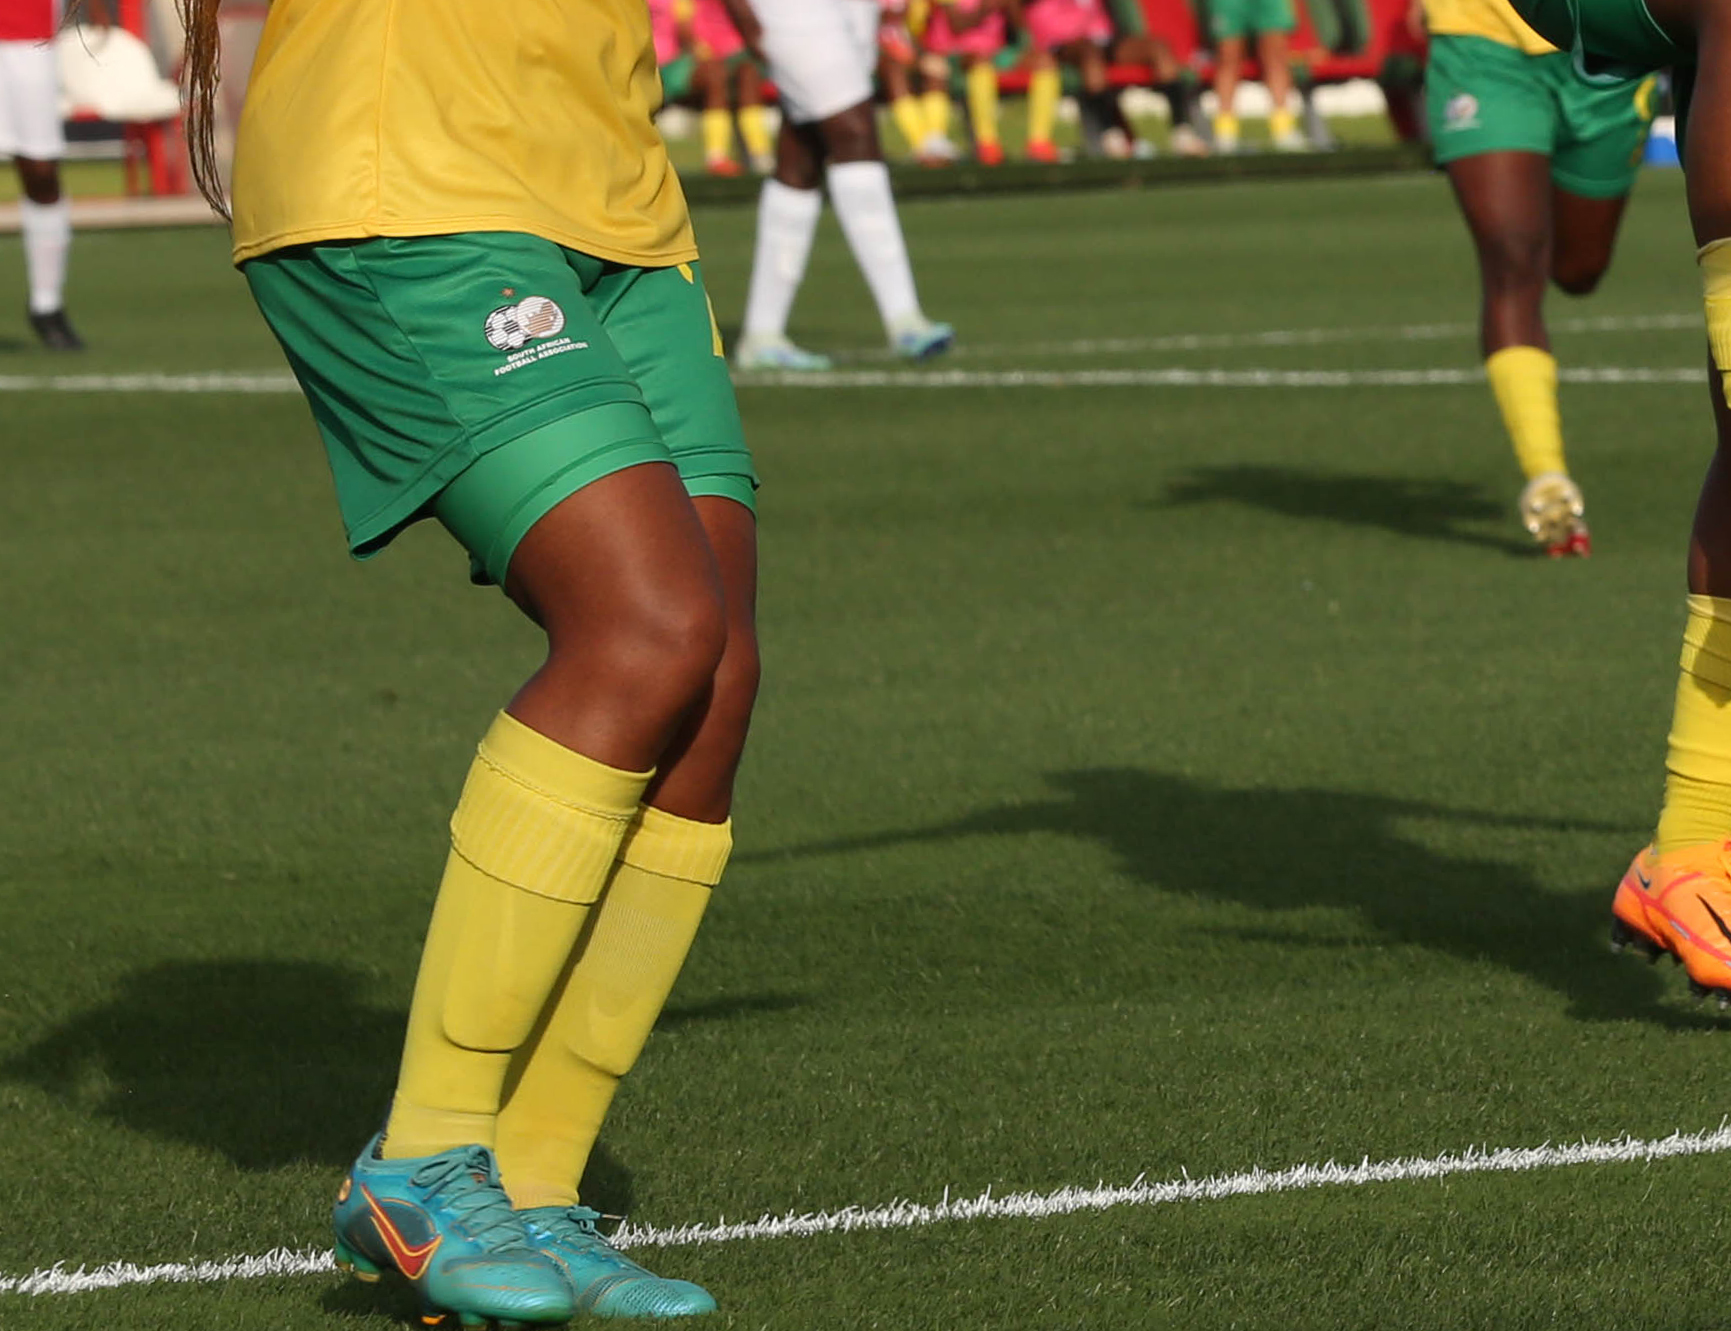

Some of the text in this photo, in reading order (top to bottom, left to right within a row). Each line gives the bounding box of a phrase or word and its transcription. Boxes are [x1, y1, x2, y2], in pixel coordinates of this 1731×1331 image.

[494, 341, 589, 376] FOOTBALL ASSOCIATION
[506, 337, 571, 363] SOUTH AFRICAN
